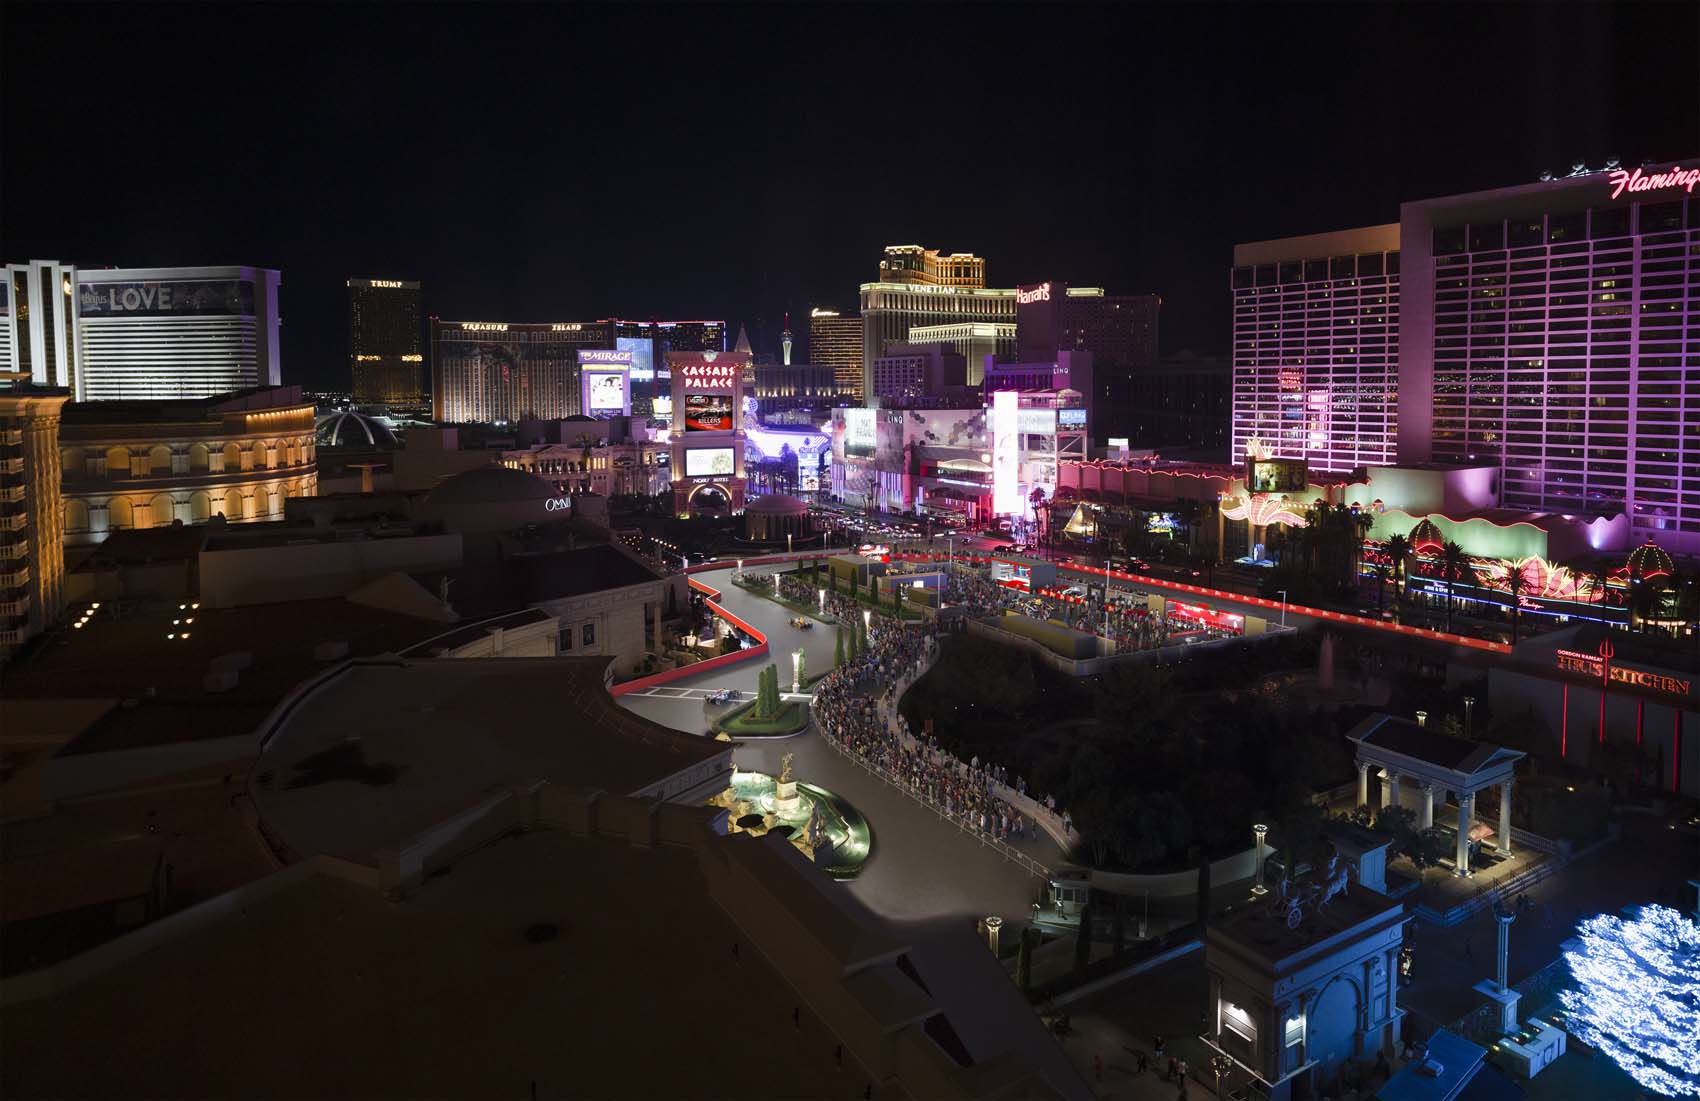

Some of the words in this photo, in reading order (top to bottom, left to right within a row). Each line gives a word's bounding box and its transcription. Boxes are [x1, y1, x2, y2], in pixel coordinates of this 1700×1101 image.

[1608, 166, 1700, 200] Flaming
[370, 279, 403, 288] TRUMP
[908, 284, 956, 294] VENETIAN
[109, 287, 172, 311] LOVE
[461, 323, 509, 332] TREASURE
[584, 351, 631, 361] MIRAGE
[682, 366, 735, 377] CAESARS
[1053, 367, 1069, 375] LINQ
[685, 378, 733, 388] PALACE
[888, 415, 903, 424] LINQ
[1557, 649, 1581, 658] GORDON
[1581, 653, 1603, 662] RAMSAY
[1608, 665, 1691, 696] KITCHEN
